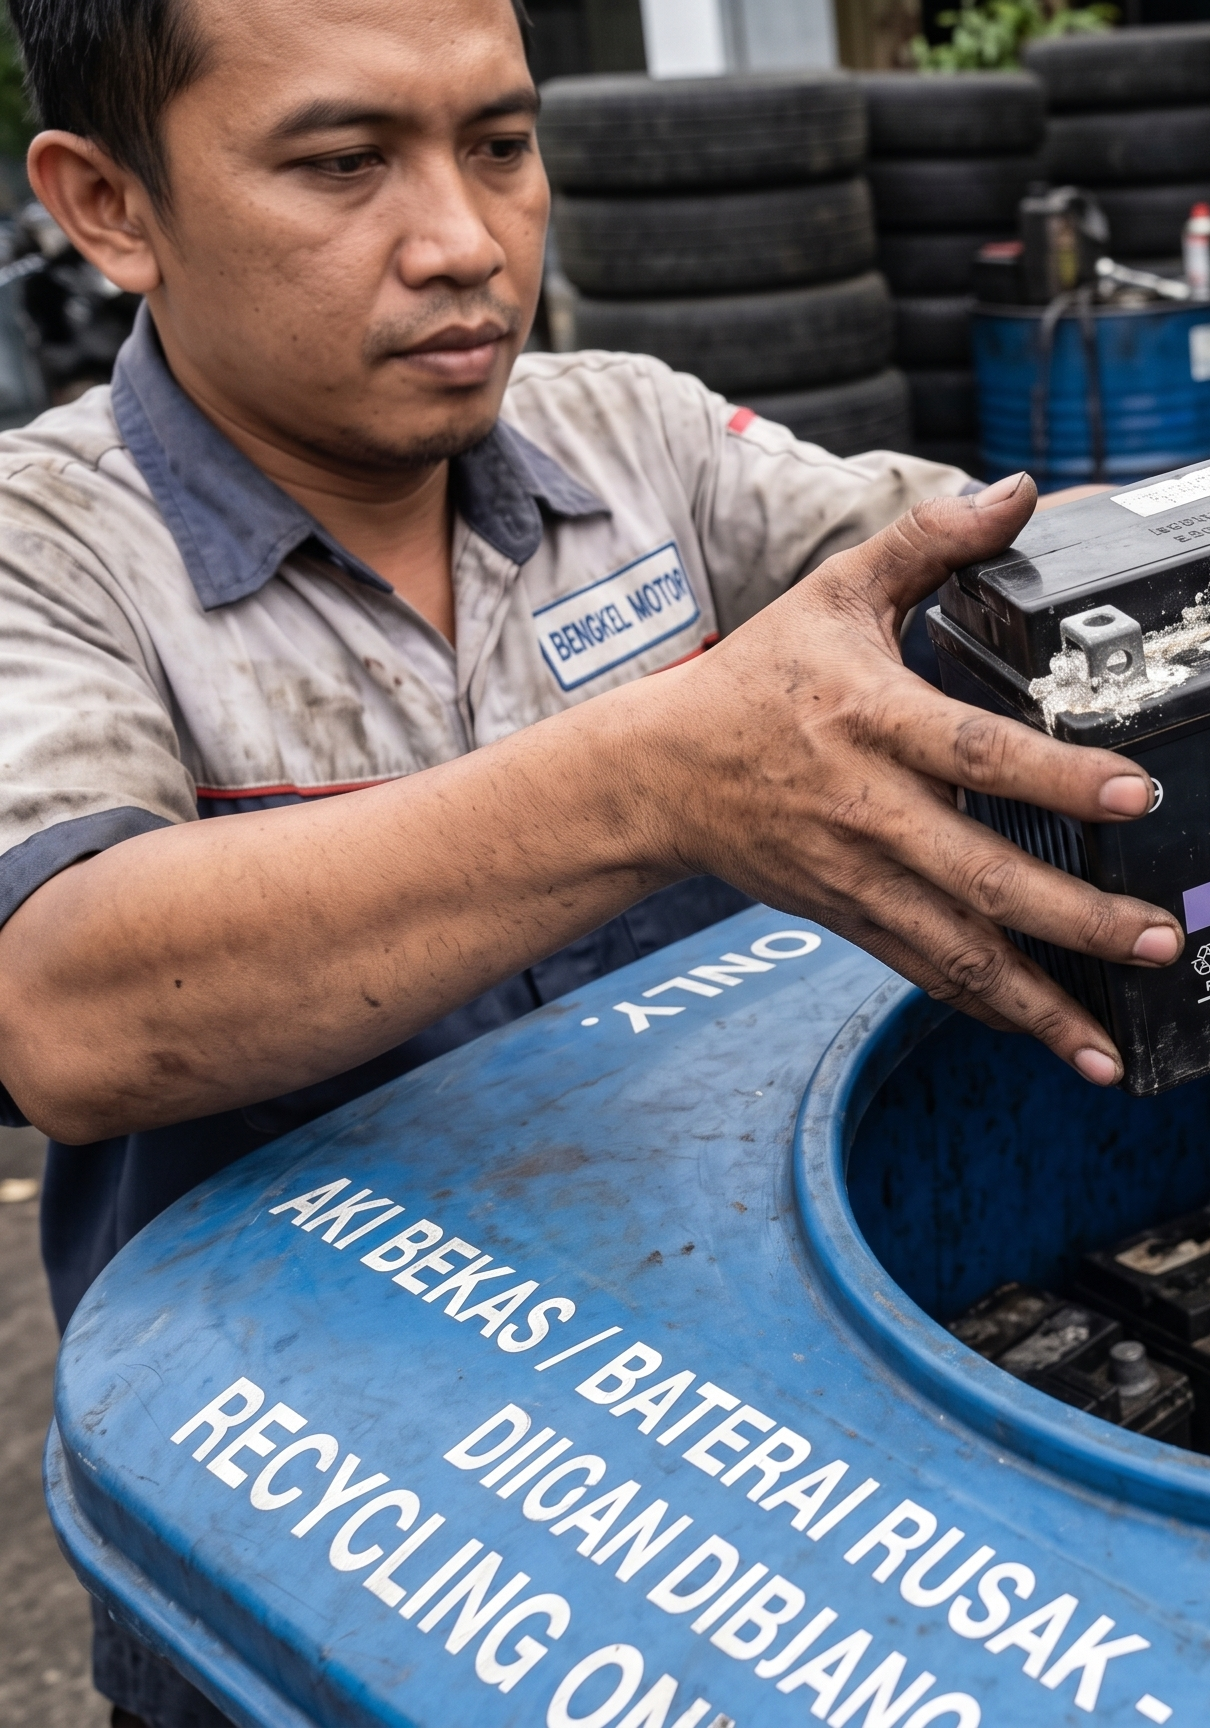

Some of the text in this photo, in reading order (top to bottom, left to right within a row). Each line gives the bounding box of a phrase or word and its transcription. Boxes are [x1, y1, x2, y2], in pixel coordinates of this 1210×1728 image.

[548, 568, 687, 661] BENGKEL MOTOR
[268, 1177, 405, 1250] AKI
[359, 1218, 576, 1354] BEKAS
[534, 1326, 623, 1371] /
[574, 1341, 880, 1541] BATERAI
[169, 1376, 571, 1693] RECYCLING
[843, 1499, 1150, 1711] RUSAK
